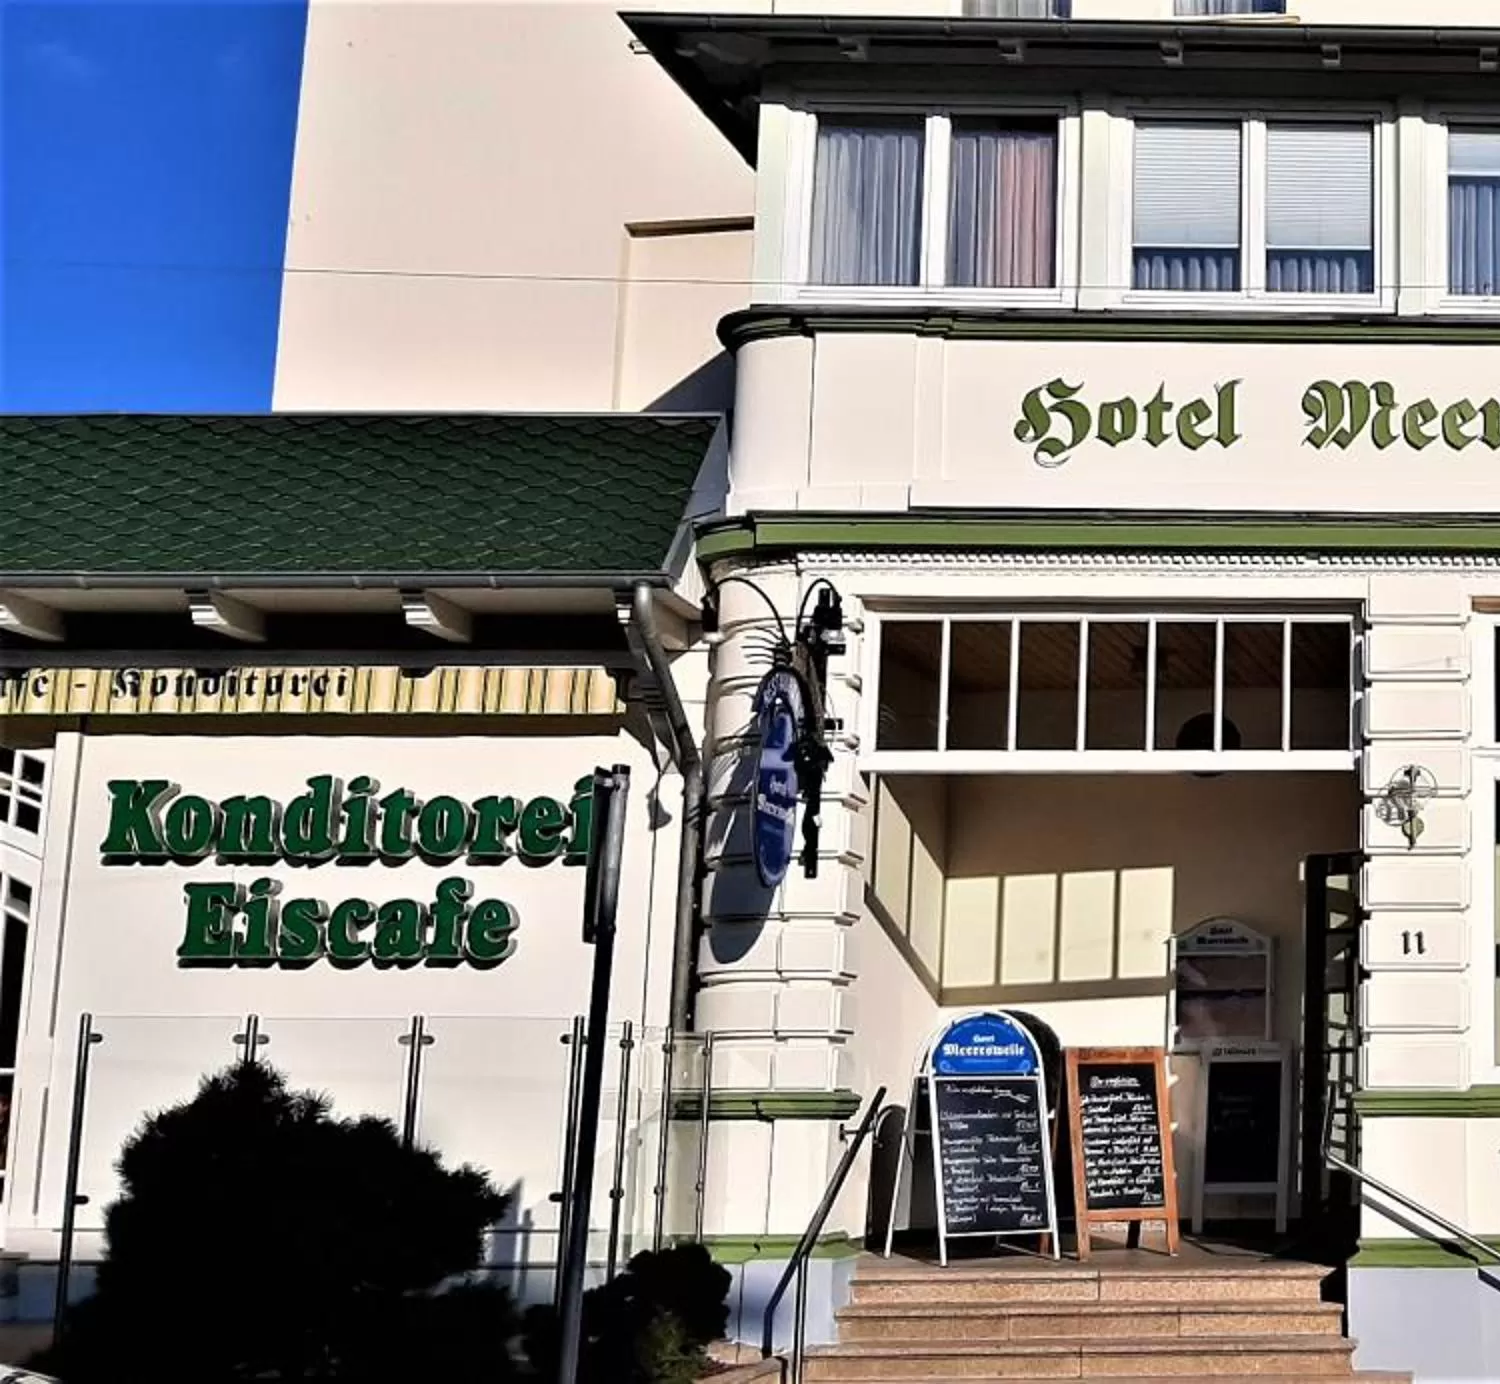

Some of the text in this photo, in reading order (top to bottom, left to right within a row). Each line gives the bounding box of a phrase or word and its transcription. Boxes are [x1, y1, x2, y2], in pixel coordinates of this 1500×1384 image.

[1013, 378, 1243, 468] Hotel
[112, 666, 348, 697] Konditorei
[100, 774, 593, 864] Konditorei
[176, 876, 517, 968] Eiscafe
[1401, 930, 1426, 955] 11
[942, 1043, 1026, 1057] Meereswelle
